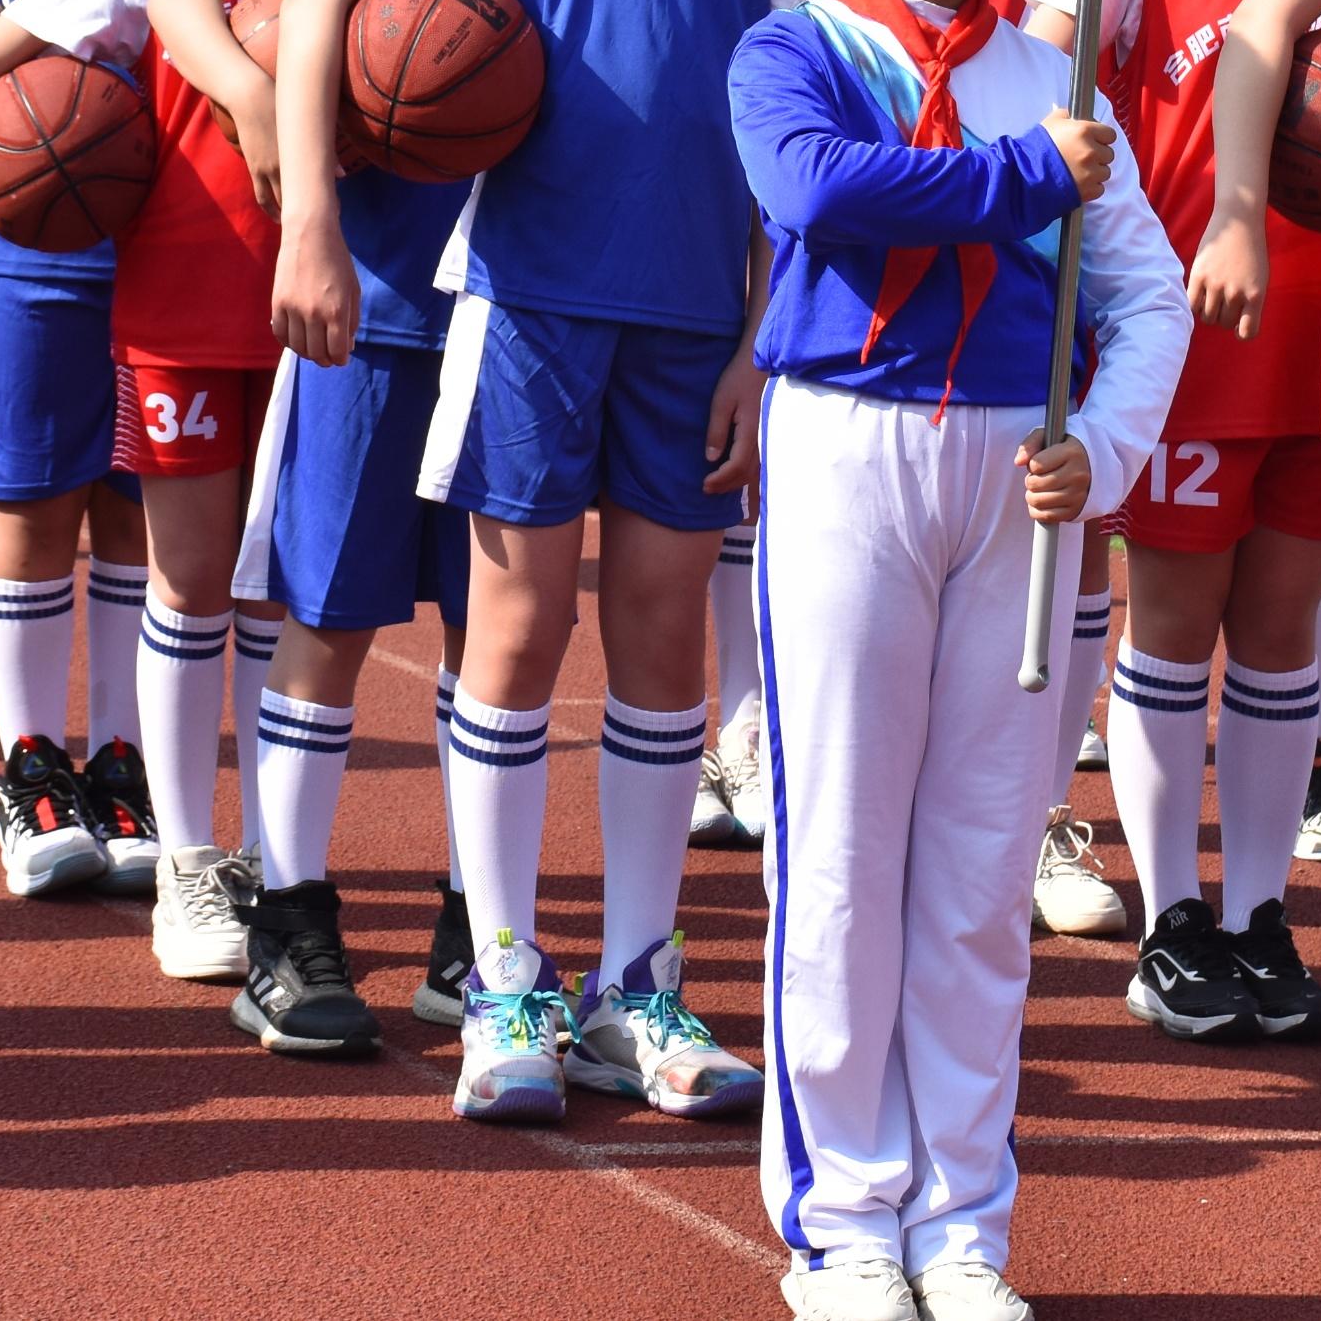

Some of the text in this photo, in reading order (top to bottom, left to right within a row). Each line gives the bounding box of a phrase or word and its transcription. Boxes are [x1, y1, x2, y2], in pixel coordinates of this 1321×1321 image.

[144, 390, 218, 444] 34
[1149, 441, 1219, 507] 12
[1169, 911, 1189, 930] AIR
